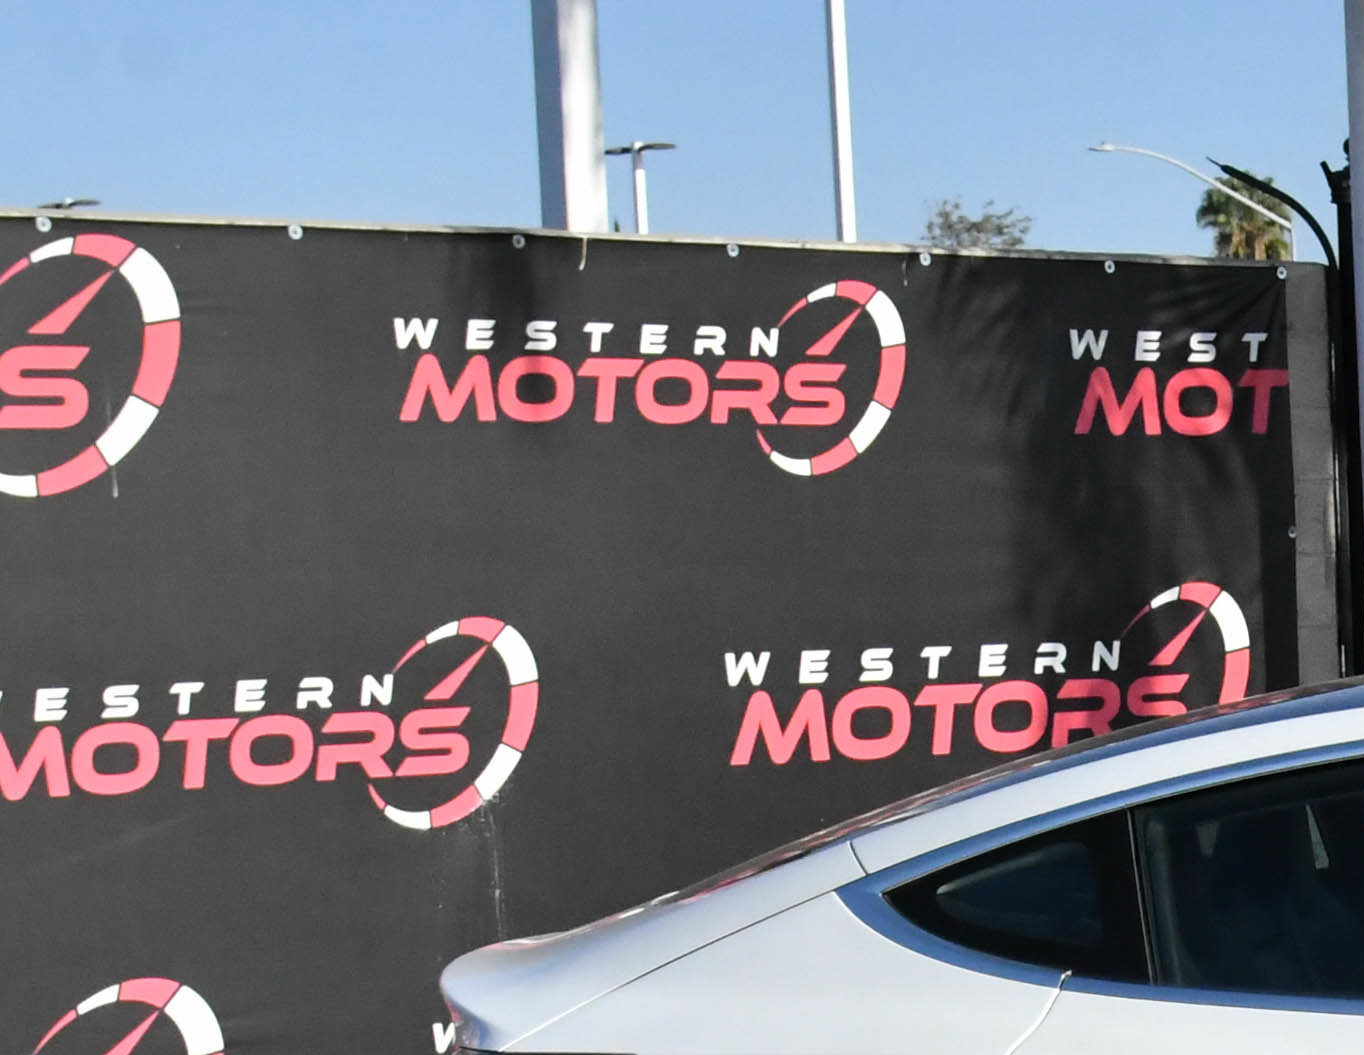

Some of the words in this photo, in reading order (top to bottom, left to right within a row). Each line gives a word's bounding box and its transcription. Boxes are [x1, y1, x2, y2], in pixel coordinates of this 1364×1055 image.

[393, 317, 779, 357] WESTERN
[1069, 328, 1269, 363] WEST
[399, 353, 847, 425] MOTORS
[1074, 366, 1290, 437] MOT
[724, 639, 1121, 687] WESTERN
[0, 673, 394, 722] ESTERN
[729, 673, 1191, 766] MOTORS
[0, 705, 471, 802] MOTORS
